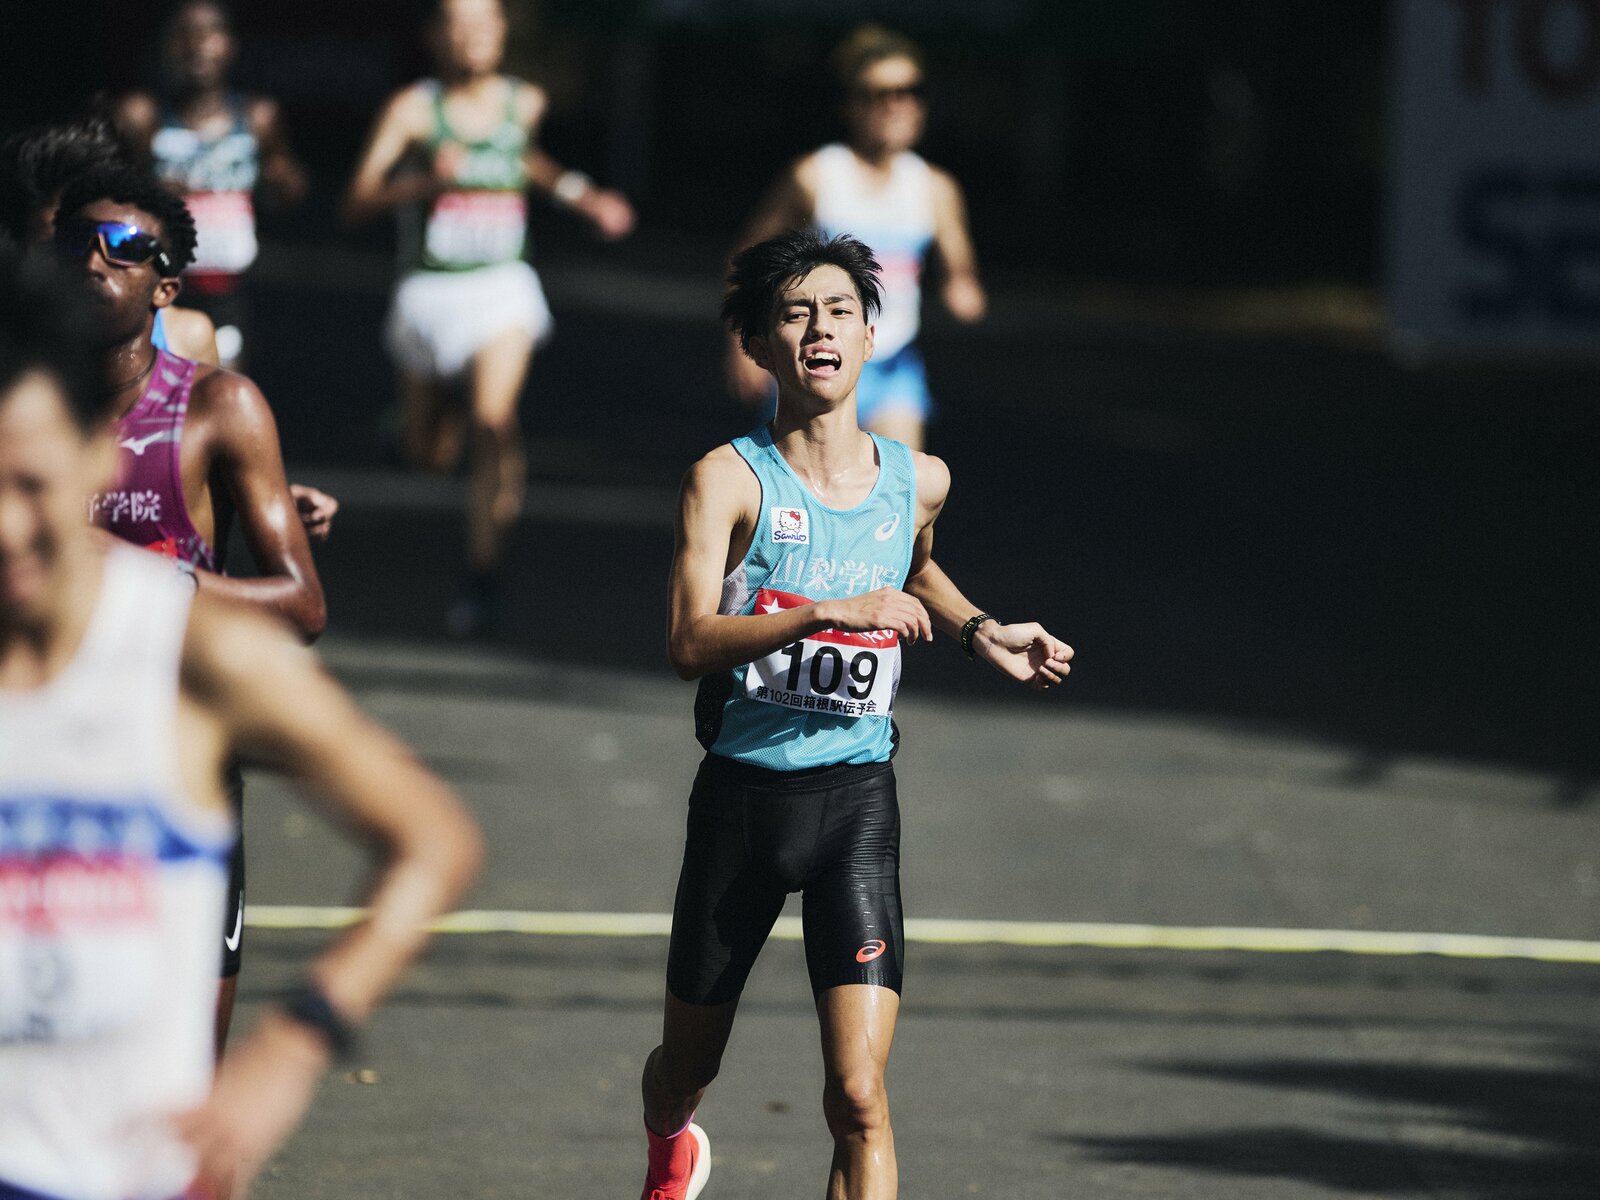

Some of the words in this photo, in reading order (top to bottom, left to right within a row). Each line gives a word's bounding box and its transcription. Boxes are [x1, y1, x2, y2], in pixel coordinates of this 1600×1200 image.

[774, 530, 807, 542] Sanrio
[769, 552, 899, 595] 山梨学院
[780, 641, 879, 700] 109
